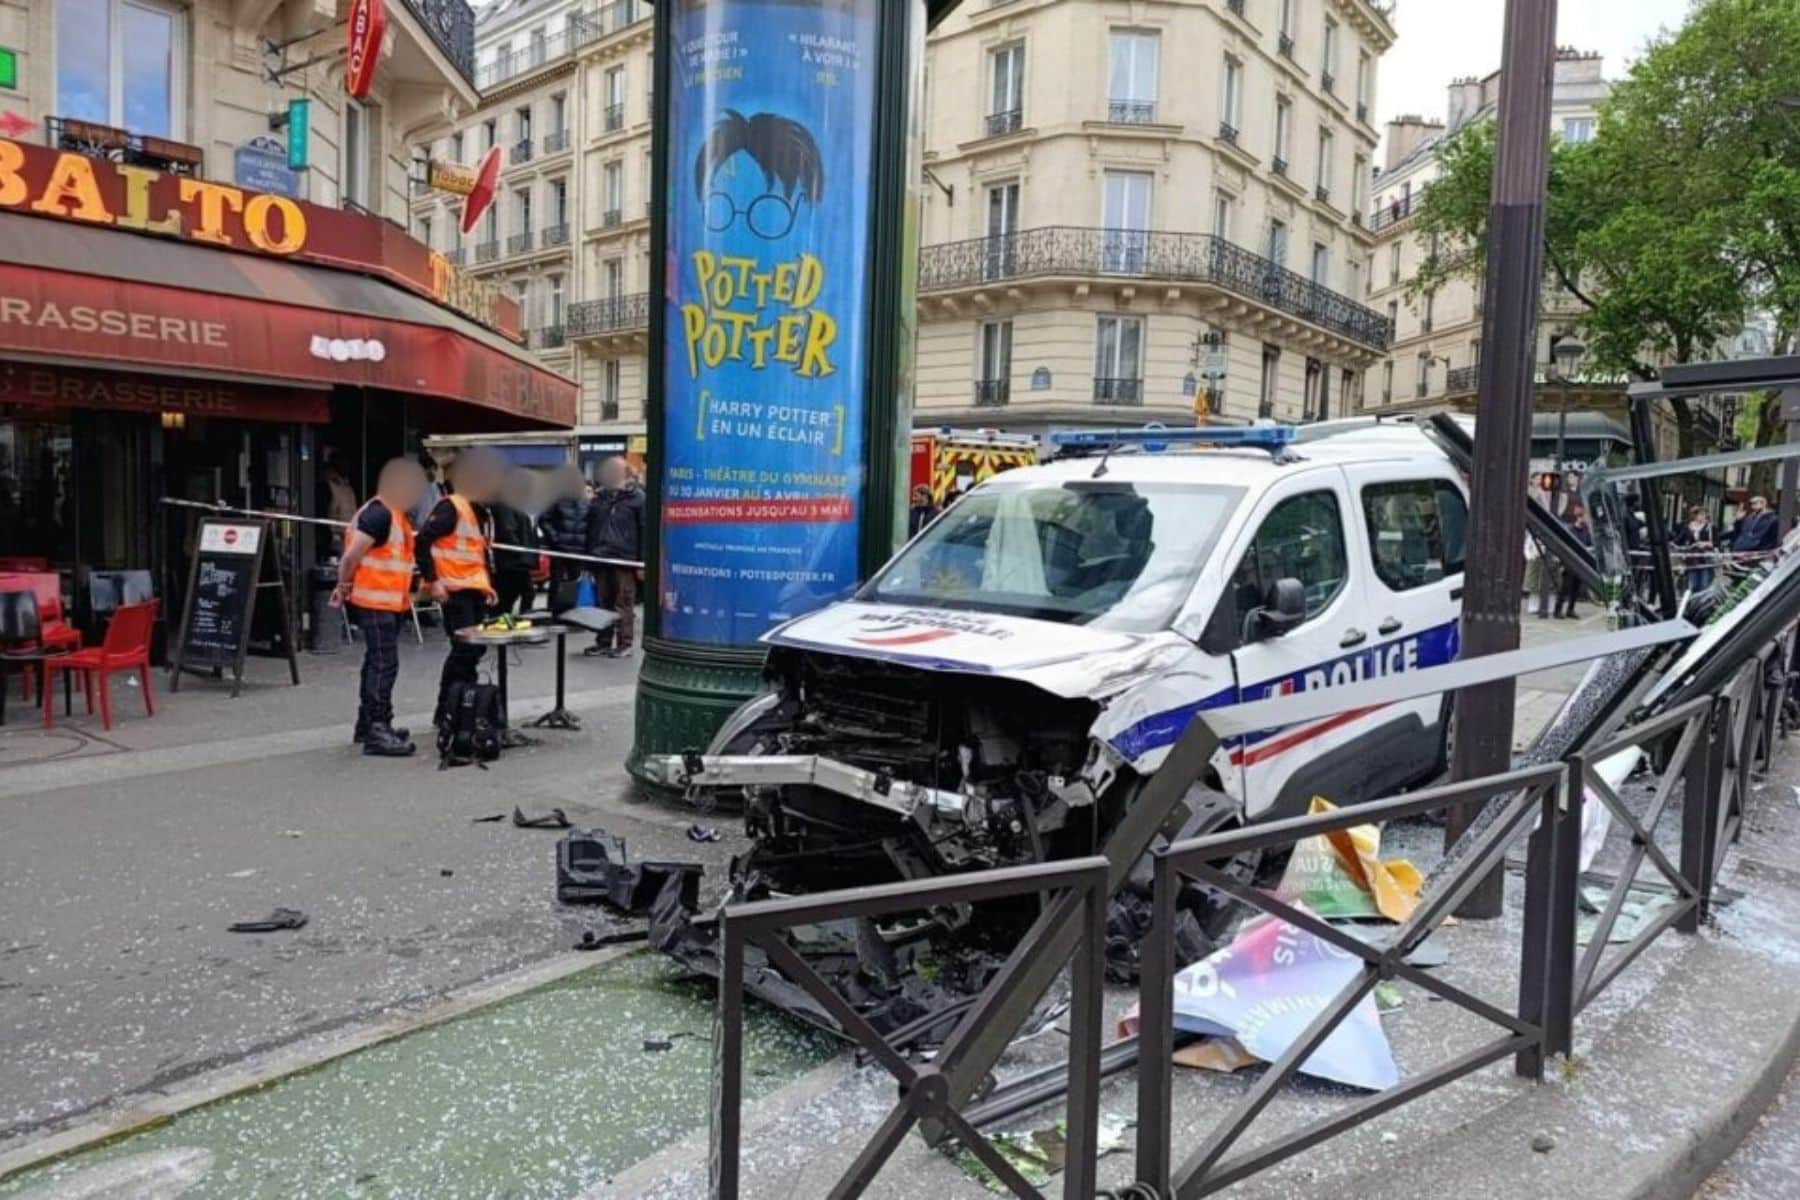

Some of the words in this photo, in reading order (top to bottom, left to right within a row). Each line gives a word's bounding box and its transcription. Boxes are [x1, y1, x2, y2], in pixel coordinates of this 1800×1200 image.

[693, 250, 824, 314] POTTED
[680, 303, 838, 381] POTTER
[710, 399, 765, 419] HARRY
[767, 404, 832, 426] POTTER
[711, 419, 732, 435] EN
[736, 421, 761, 438] UN
[767, 423, 824, 446] ÉCLAIR
[704, 466, 755, 483] THÉÂTRE
[760, 470, 778, 484] DU
[694, 487, 740, 500] JANVIER
[1304, 637, 1418, 692] POLICE
